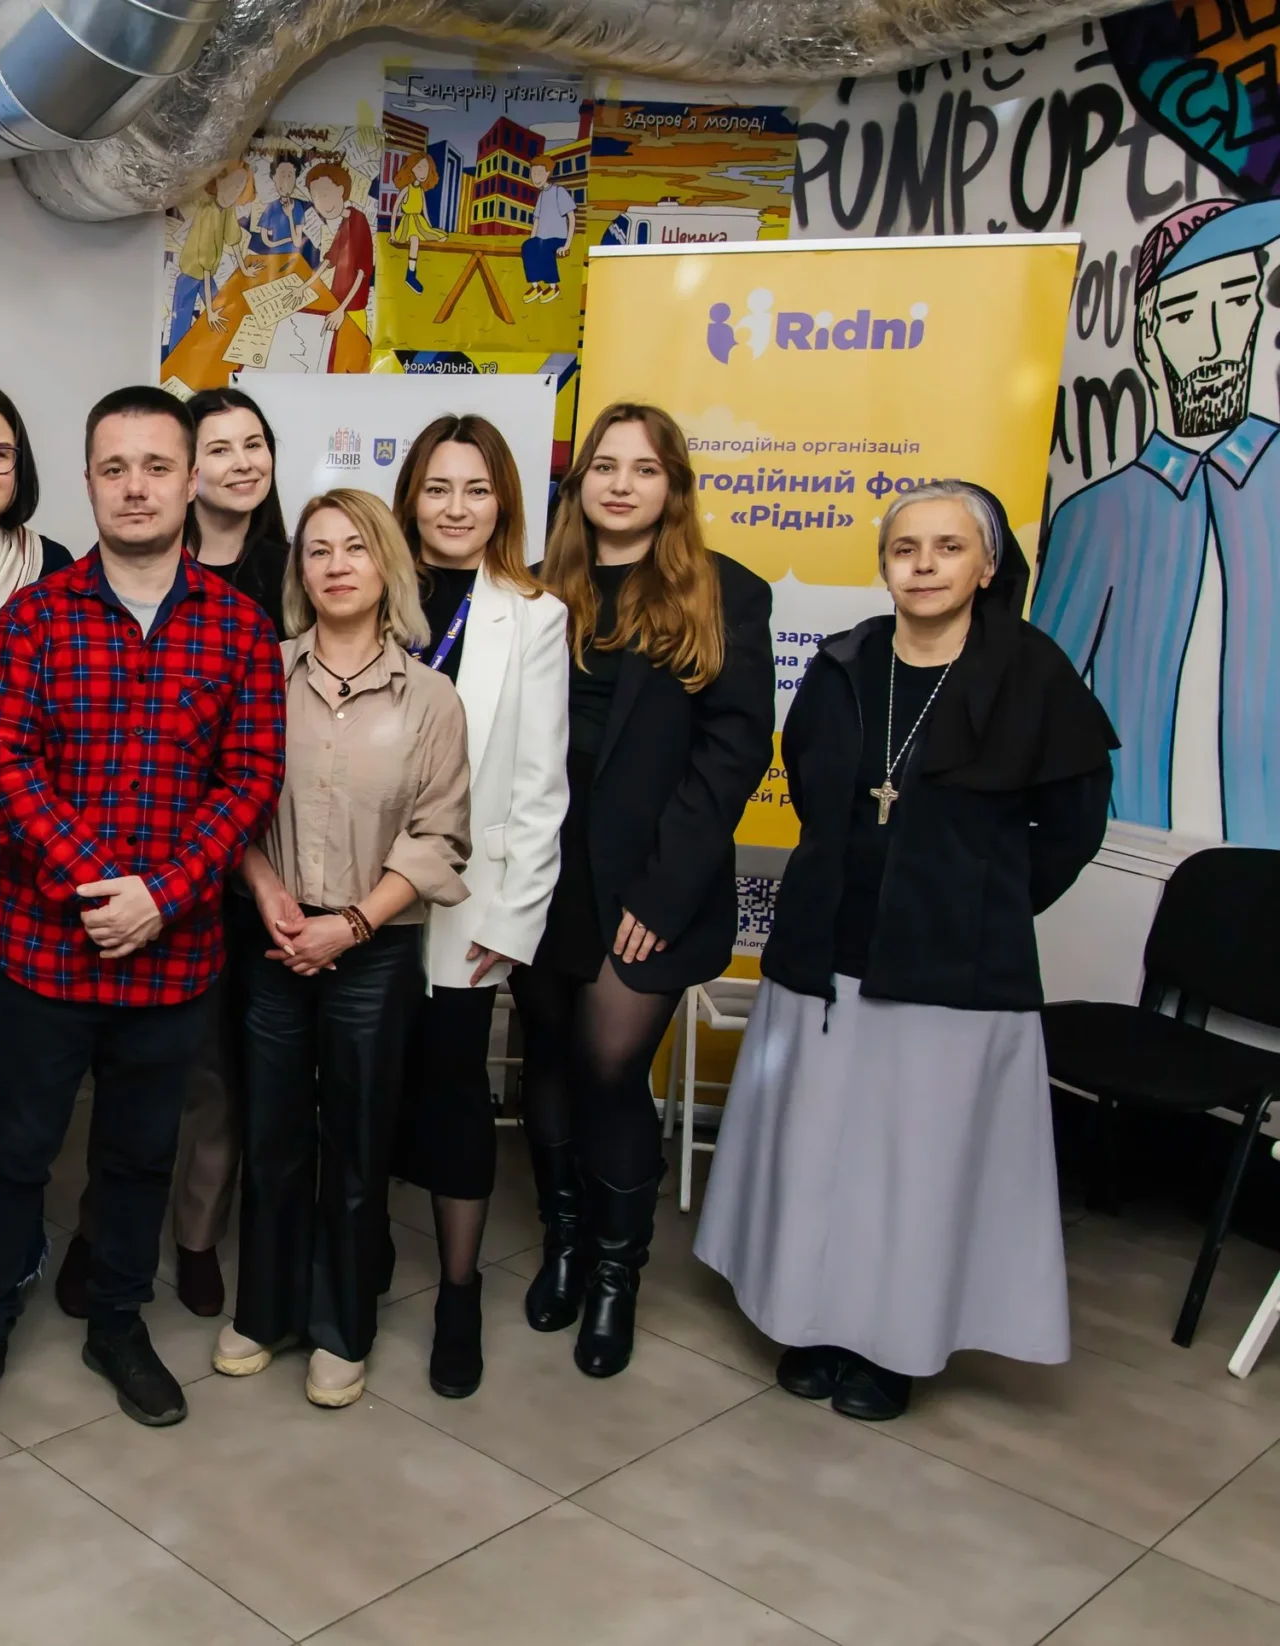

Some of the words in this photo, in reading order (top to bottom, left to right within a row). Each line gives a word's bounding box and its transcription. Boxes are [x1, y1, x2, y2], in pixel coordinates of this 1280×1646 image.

[407, 75, 496, 111] Гендерна
[703, 115, 768, 134] молоді
[793, 88, 999, 237] PUMP
[1009, 82, 1124, 232] UP
[775, 301, 930, 351] Ridni
[403, 359, 475, 375] формальна
[687, 437, 797, 453] Благодійна
[802, 439, 921, 455] організація
[325, 453, 361, 465] ЛЬВІВ
[730, 503, 855, 531] «Рідні»
